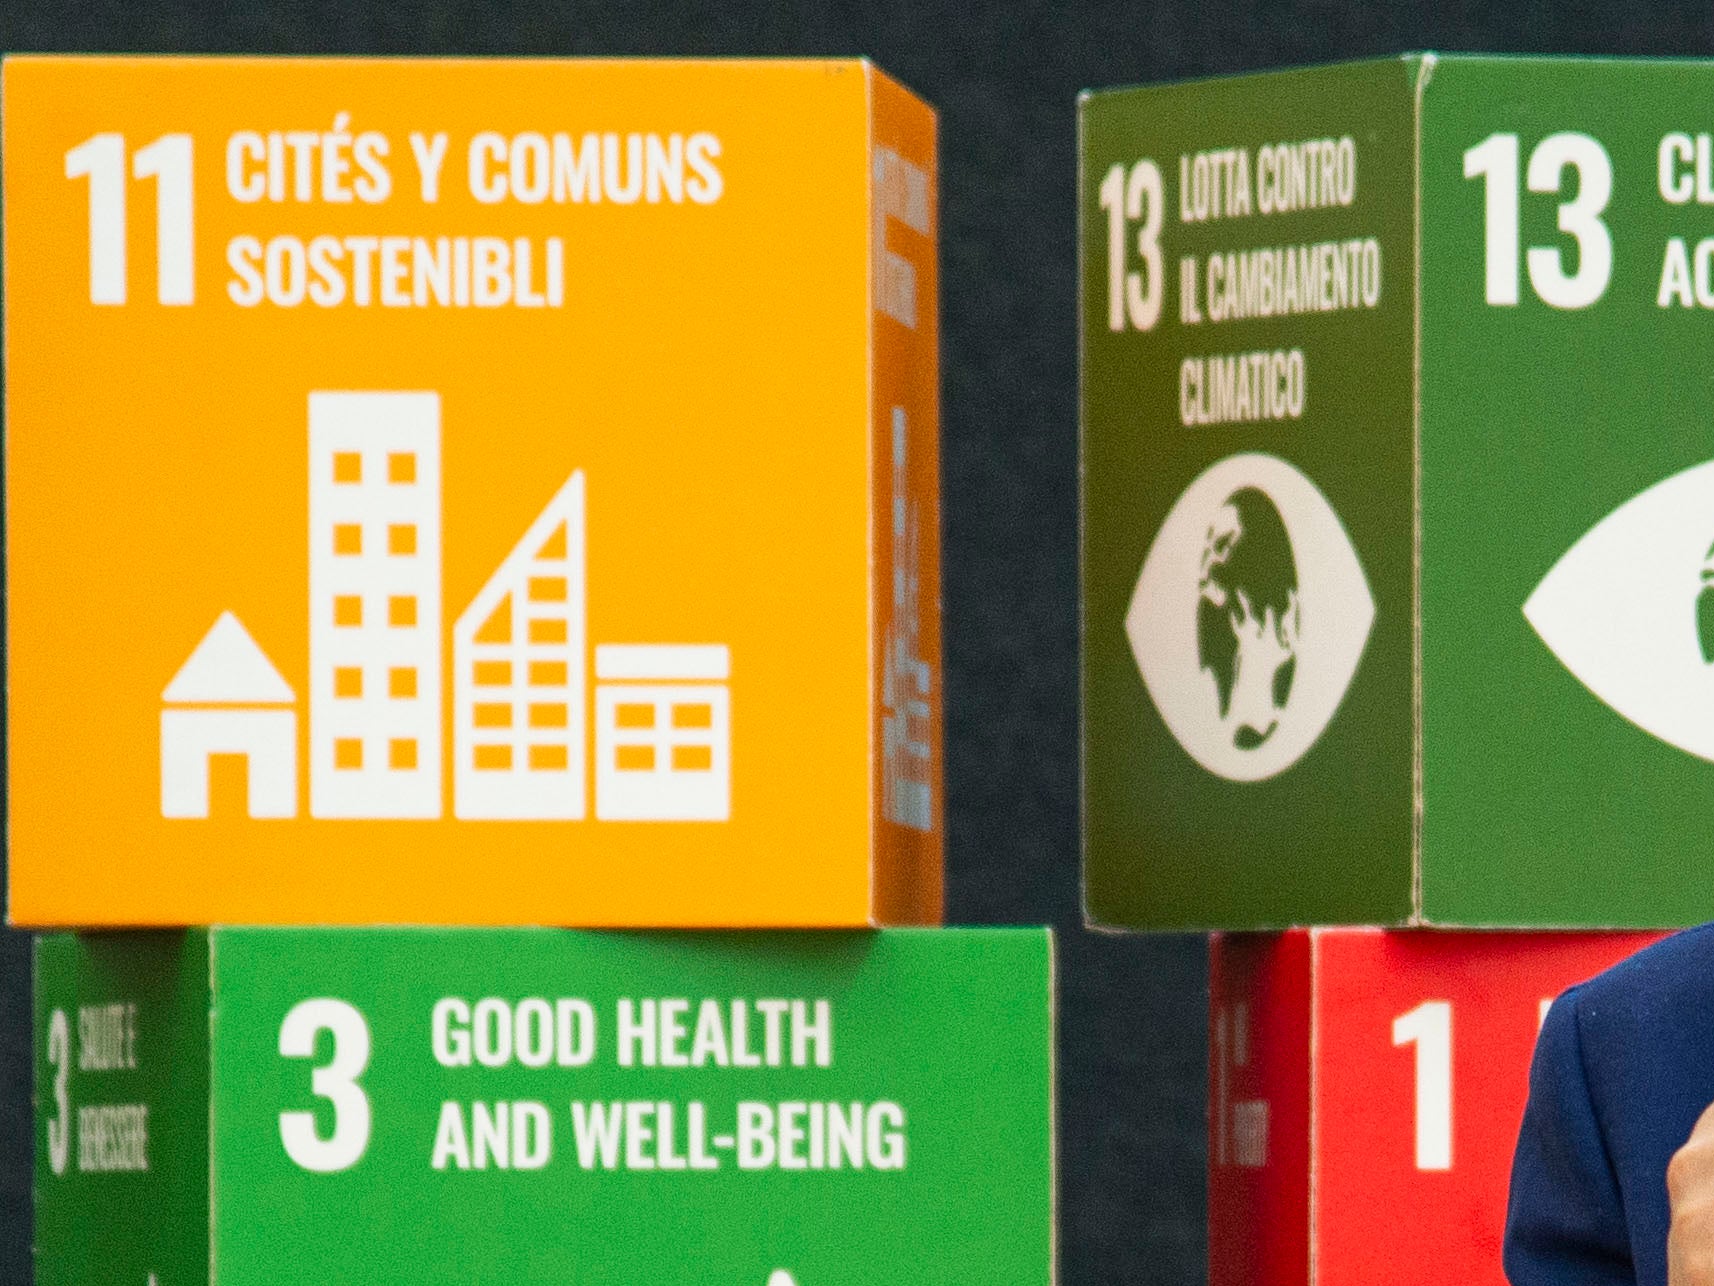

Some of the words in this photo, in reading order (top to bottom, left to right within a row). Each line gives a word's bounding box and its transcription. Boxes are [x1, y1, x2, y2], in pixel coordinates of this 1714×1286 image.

[226, 111, 392, 205] CITÉS
[409, 132, 449, 203] Y
[468, 132, 724, 205] COMUNS
[1179, 149, 1251, 222] LOTTA
[1257, 134, 1356, 215] CONTRO
[65, 133, 195, 306] 11
[1100, 157, 1165, 332] 13
[1463, 132, 1613, 309] 13
[227, 235, 564, 308] SOSTENIBLI
[1179, 254, 1203, 325] IL
[1207, 236, 1379, 322] CAMBIAMENTO
[1179, 347, 1305, 426] CLIMATICO
[431, 996, 597, 1068] GOOD
[616, 997, 832, 1068] HEALTH
[49, 1009, 68, 1174] 3
[278, 997, 372, 1173] 3
[1392, 1001, 1453, 1171] 1
[431, 1100, 552, 1171] AND
[571, 1100, 906, 1170] WELL-BEING
